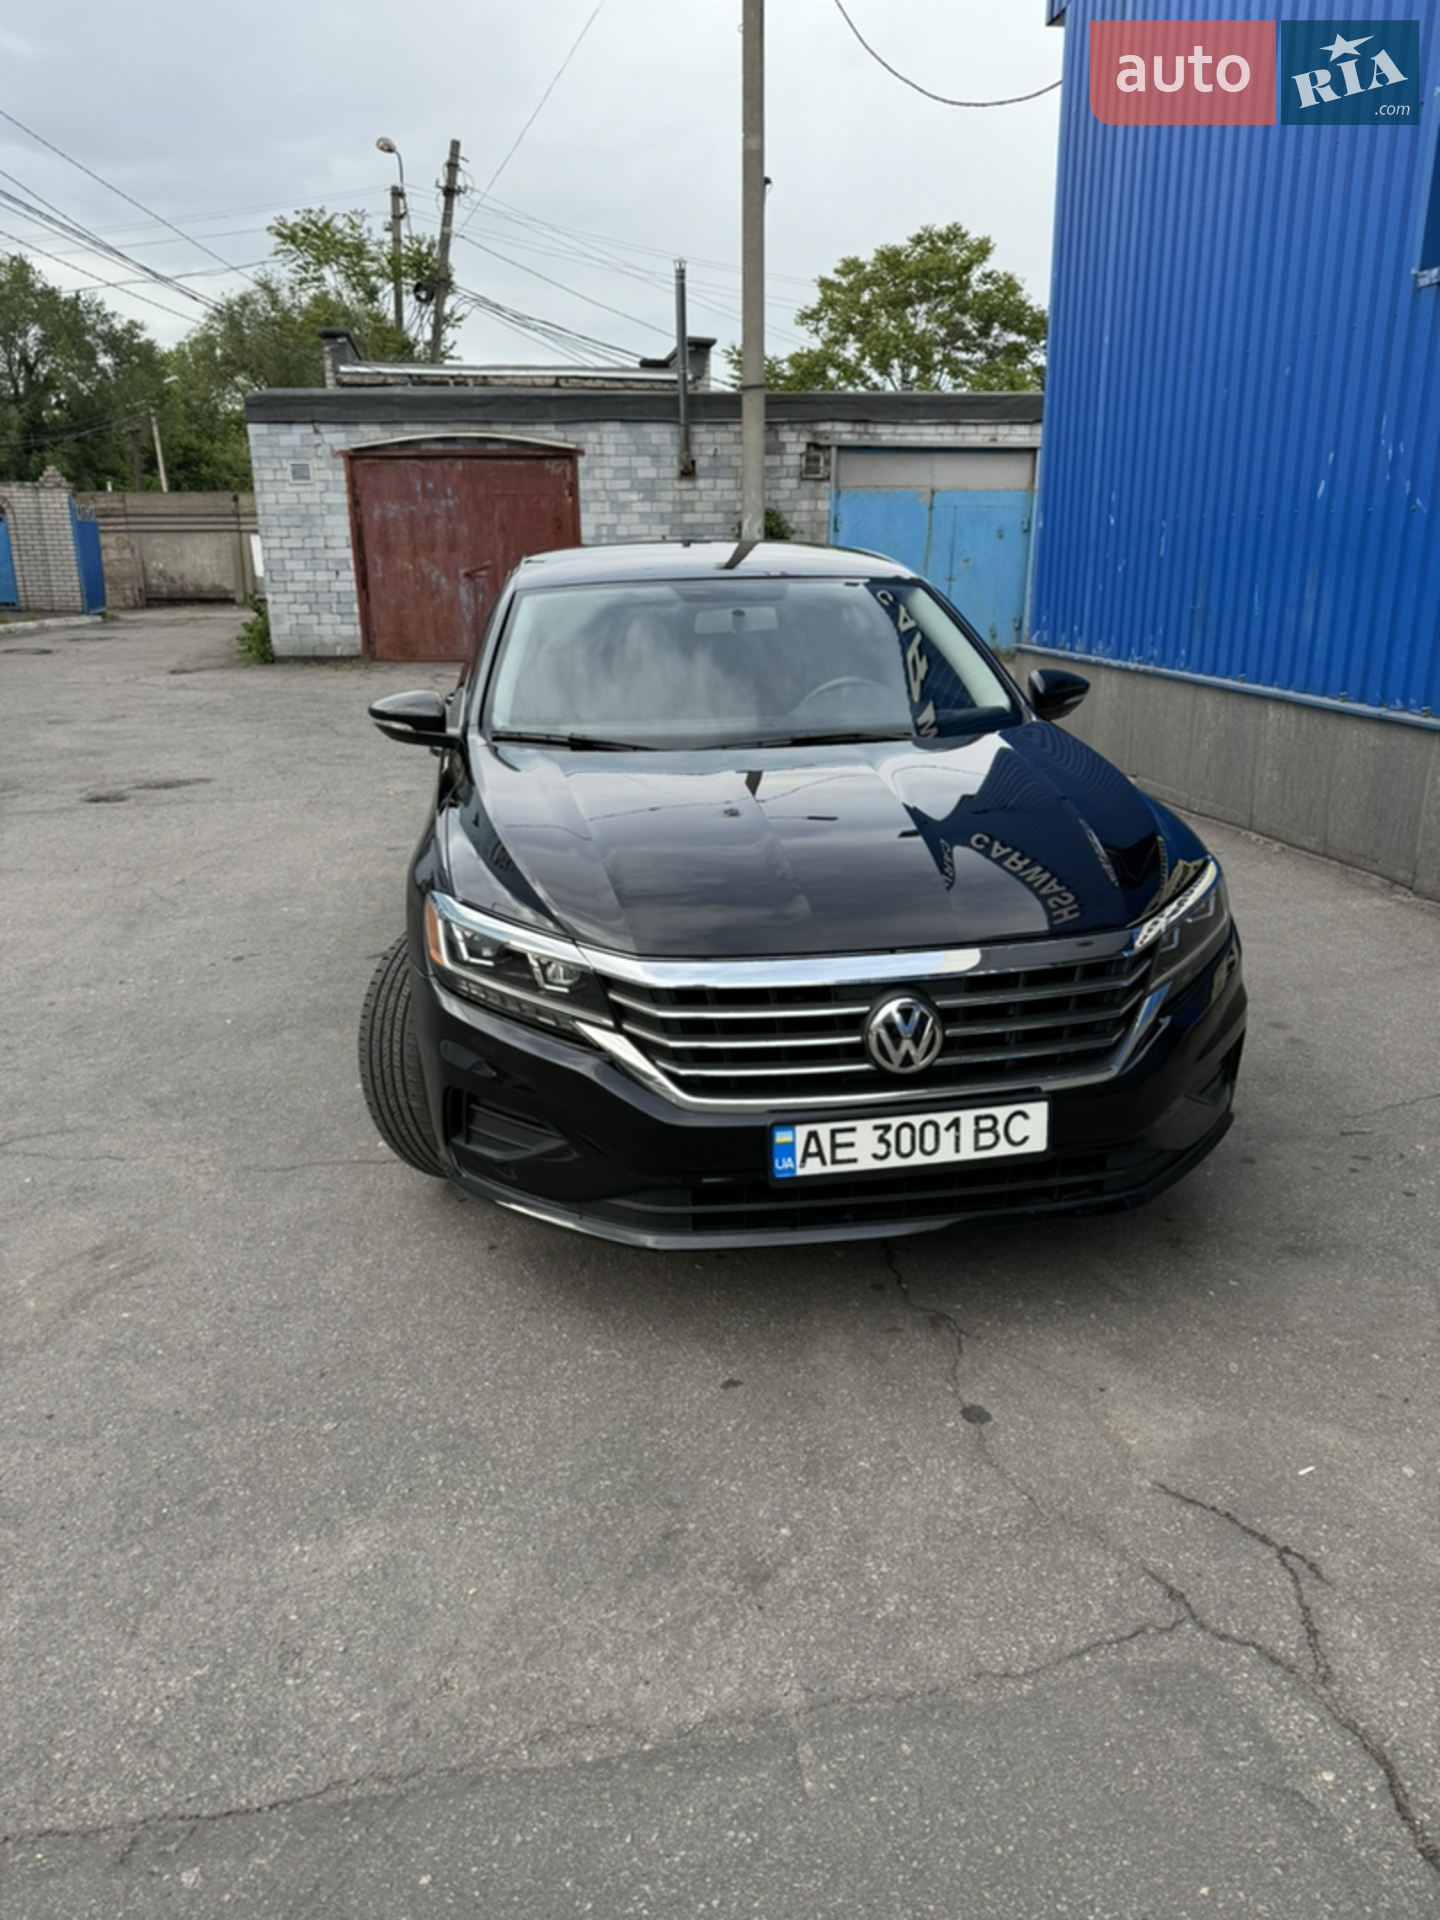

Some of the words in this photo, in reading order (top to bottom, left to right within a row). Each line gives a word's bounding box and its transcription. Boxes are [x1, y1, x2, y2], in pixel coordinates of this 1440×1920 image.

[799, 1127, 858, 1169] AE
[871, 1116, 961, 1162] 3001
[973, 1109, 1030, 1152] BC
[775, 1156, 795, 1170] UA
